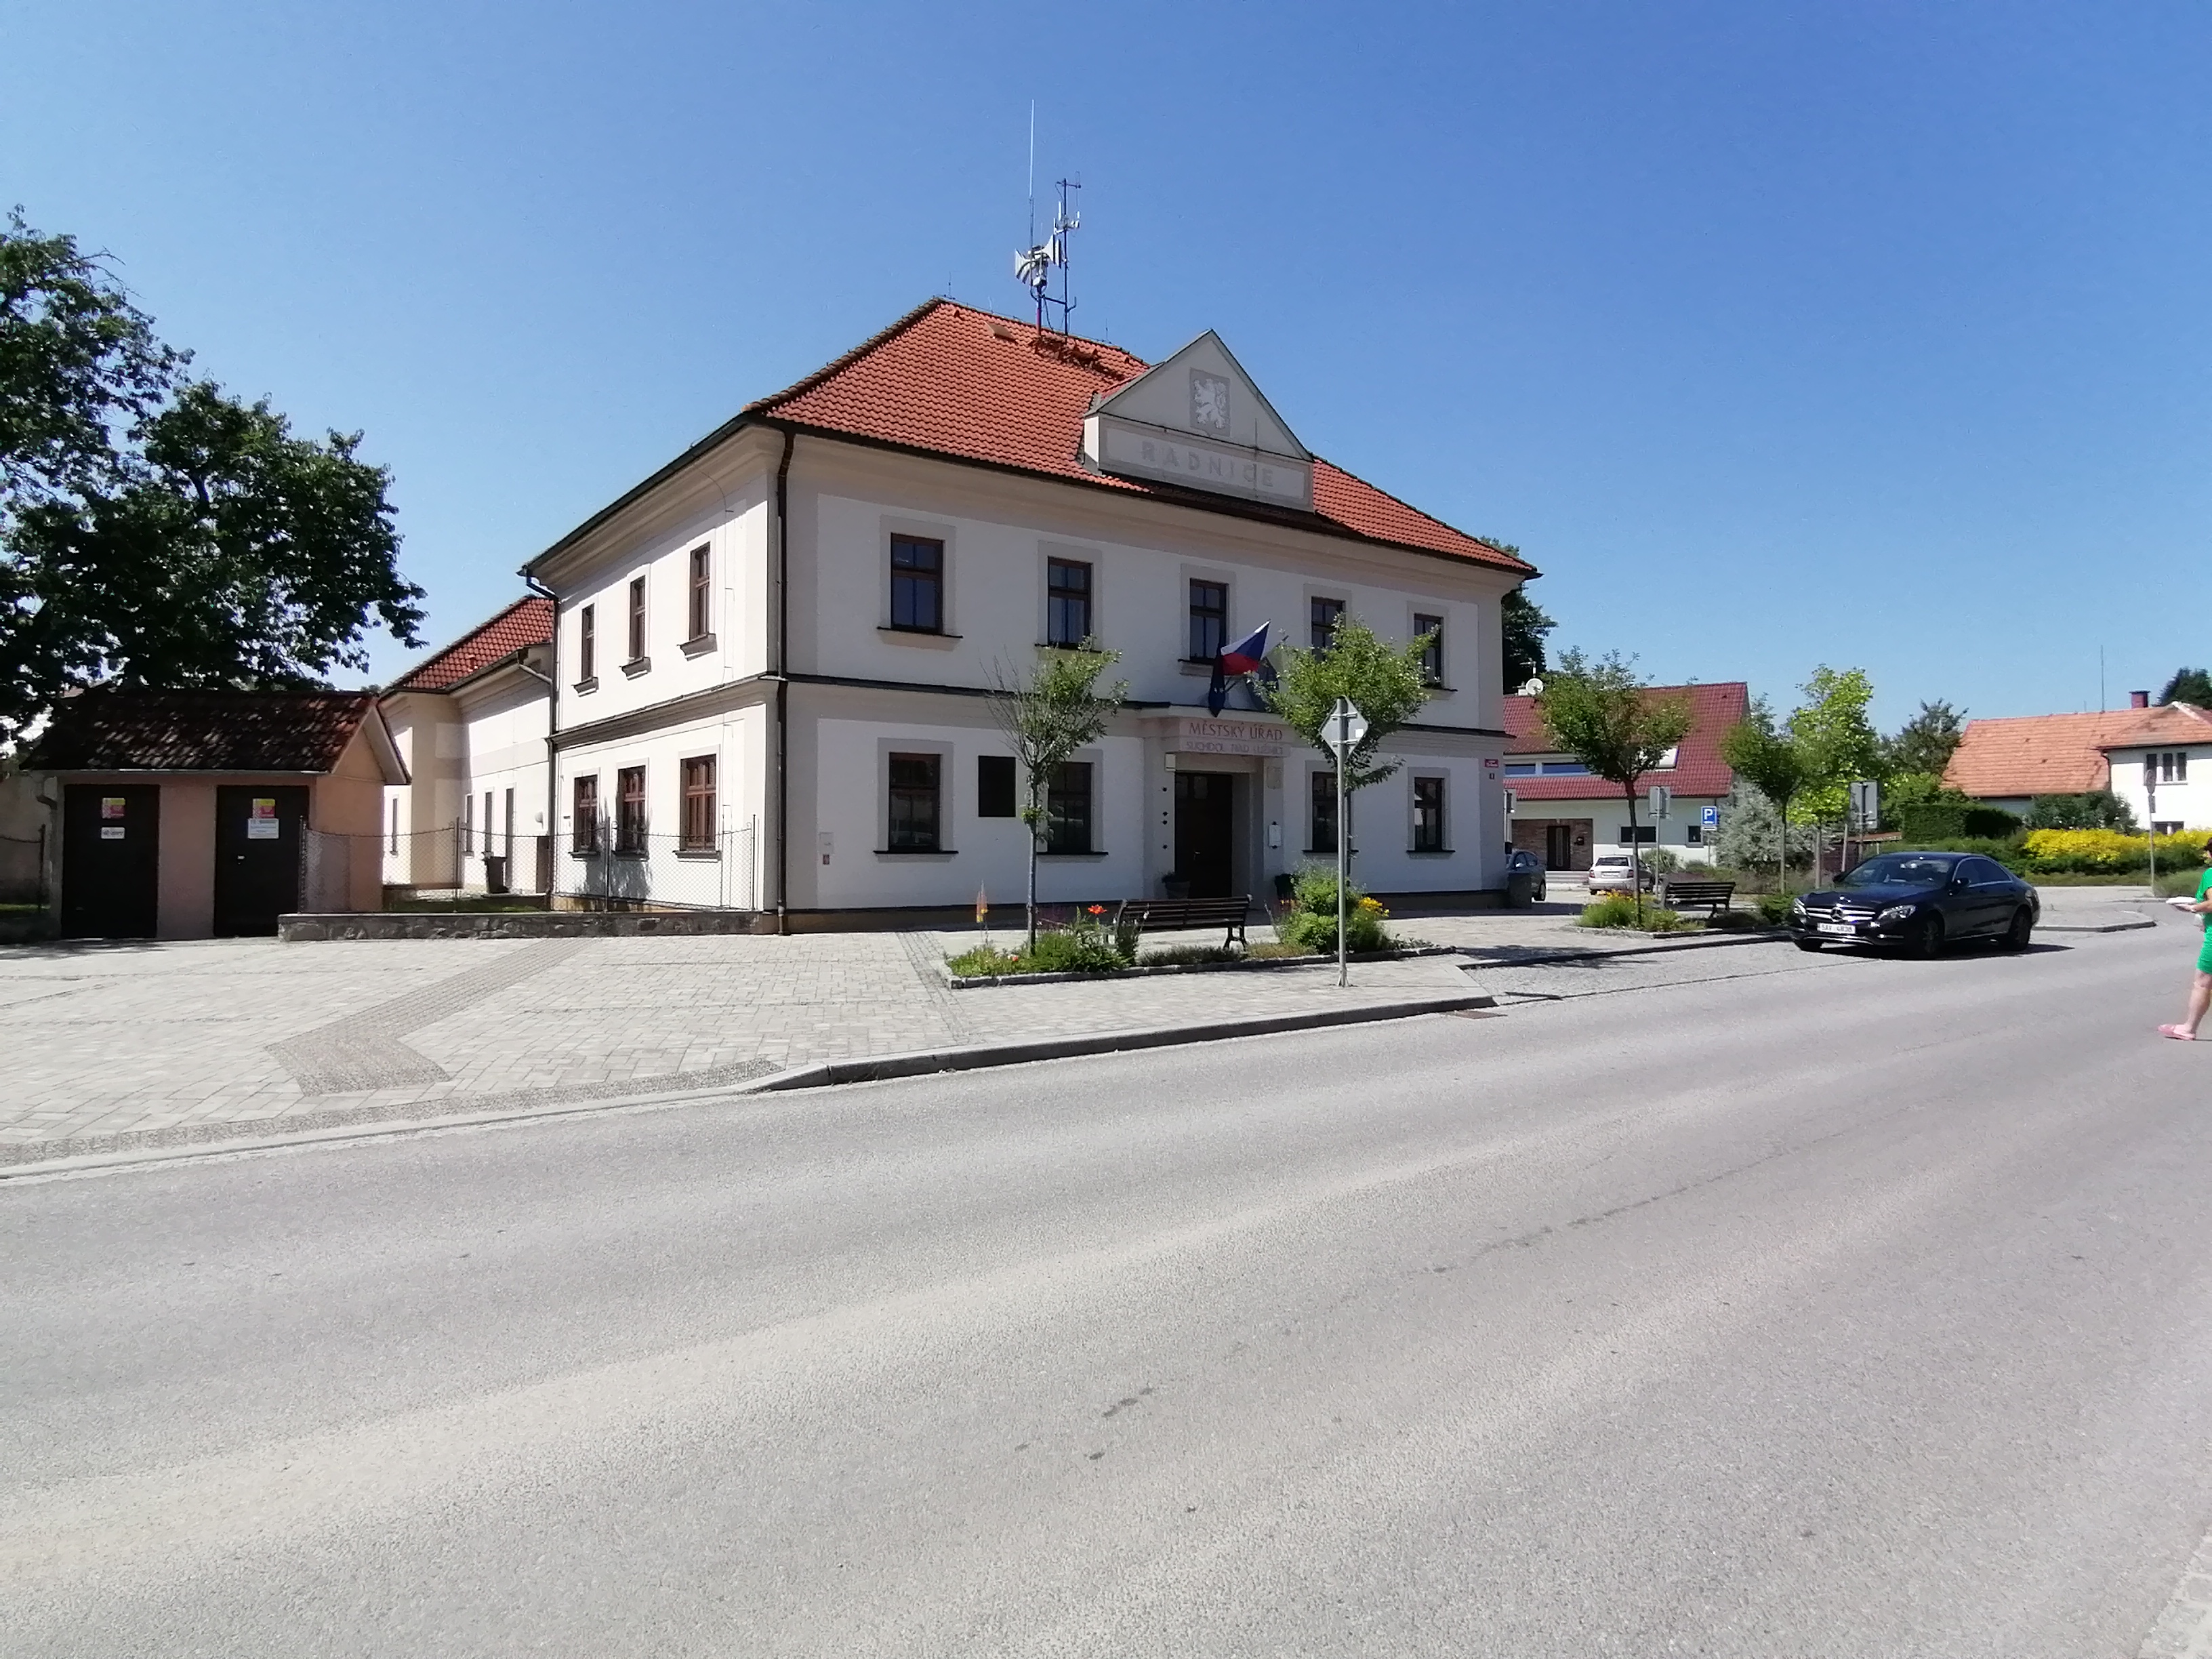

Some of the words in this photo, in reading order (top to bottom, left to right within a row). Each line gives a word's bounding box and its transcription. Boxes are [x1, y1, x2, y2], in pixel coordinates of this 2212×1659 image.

[1141, 441, 1274, 487] RADNICE
[1189, 719, 1245, 738] MĚSTSKÝ
[1250, 723, 1284, 741] ÚŘAD
[1704, 808, 1713, 820] P
